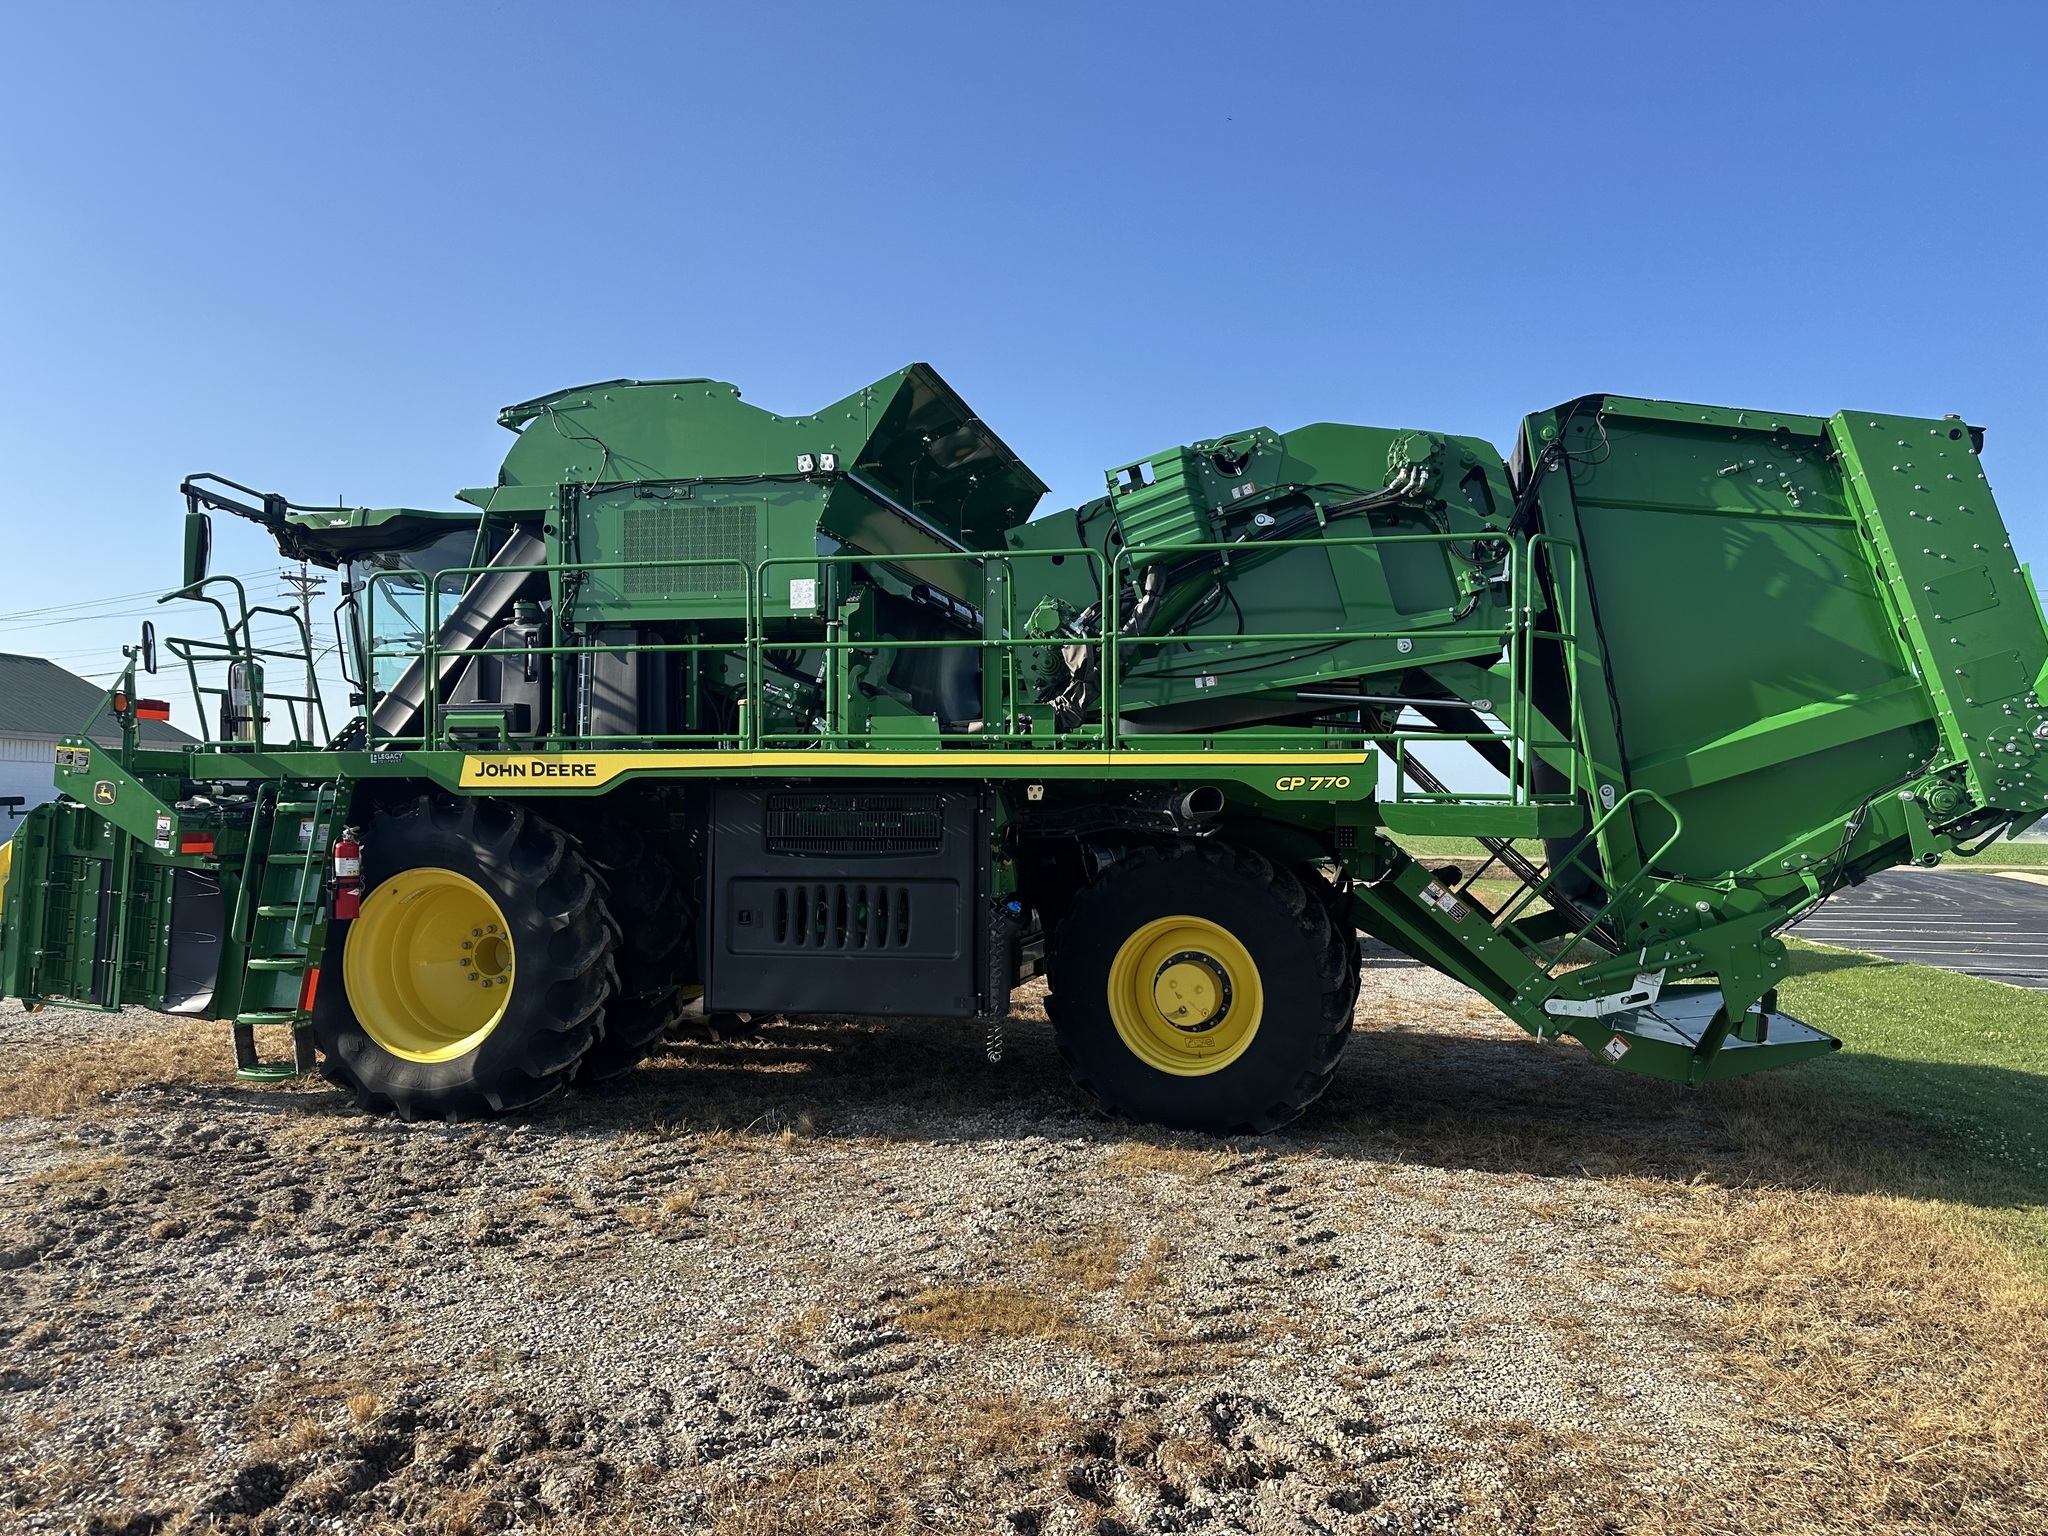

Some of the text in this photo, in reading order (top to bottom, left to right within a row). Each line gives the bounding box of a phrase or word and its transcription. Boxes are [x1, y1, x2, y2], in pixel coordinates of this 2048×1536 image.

[377, 752, 403, 760] LEGACY
[475, 761, 597, 777] JOHN DEERE
[1275, 775, 1351, 791] CP 770
